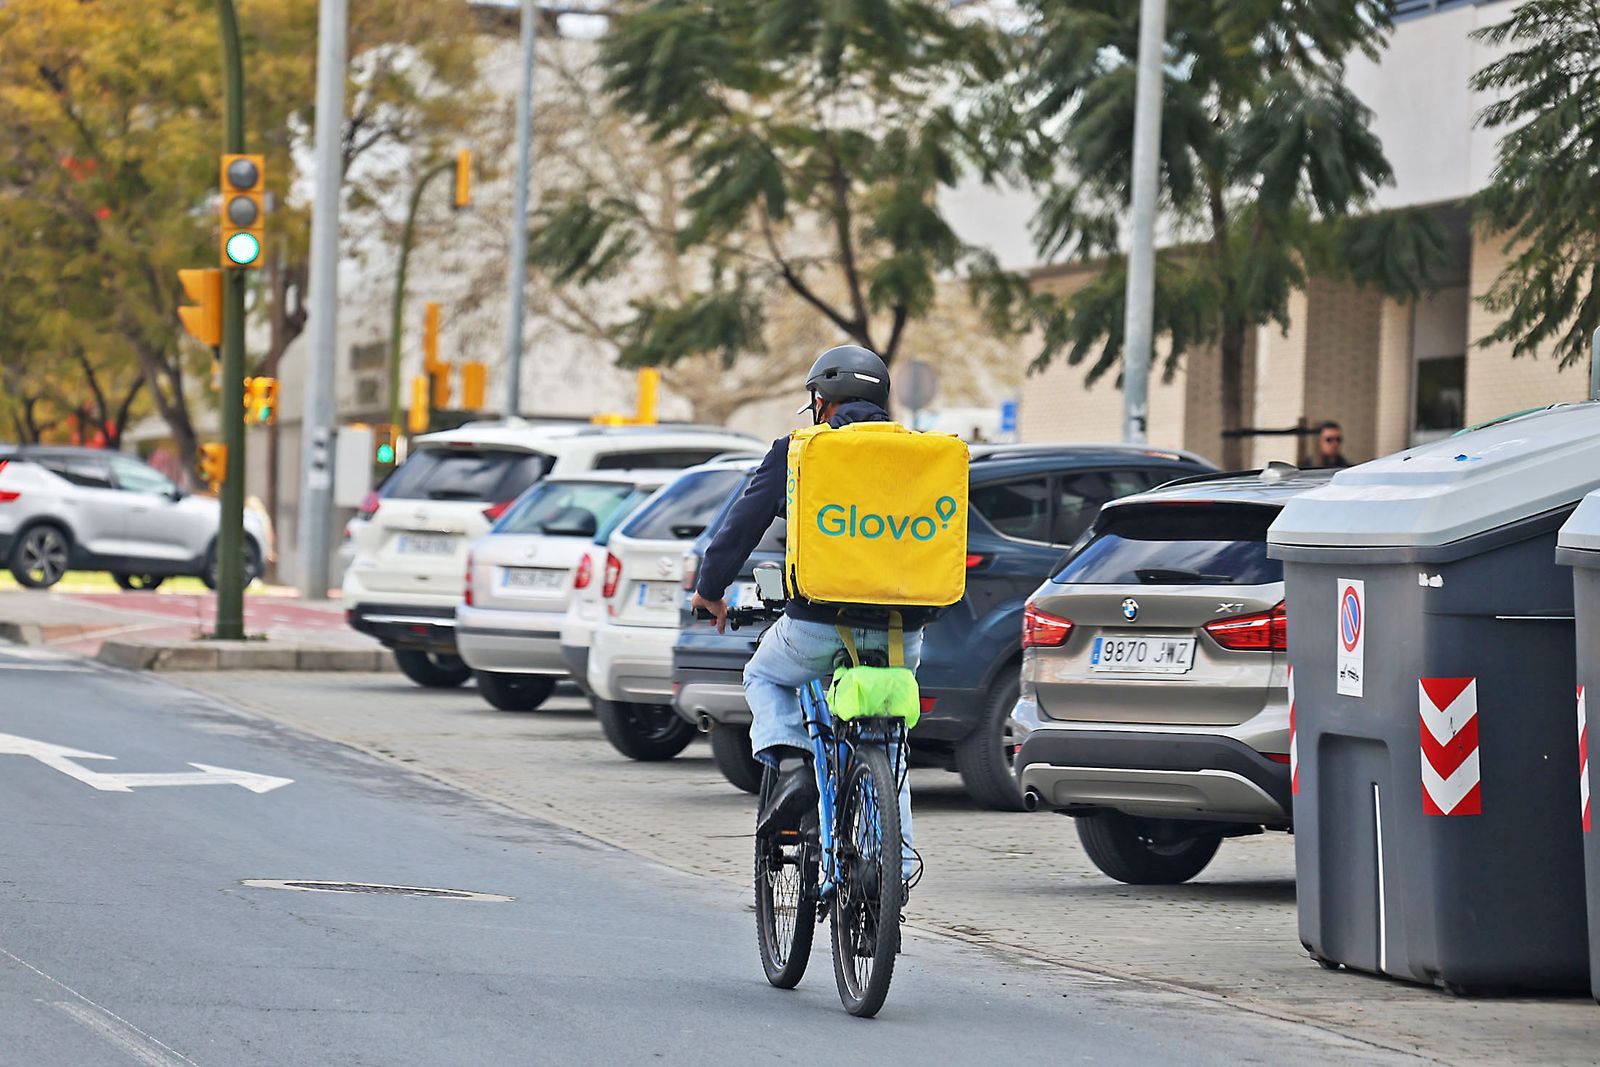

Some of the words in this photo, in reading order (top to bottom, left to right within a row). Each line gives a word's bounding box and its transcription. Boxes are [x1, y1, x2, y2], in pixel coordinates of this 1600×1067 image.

[817, 503, 937, 542] Glovo
[1214, 602, 1246, 613] X1
[1103, 641, 1148, 663] 9870
